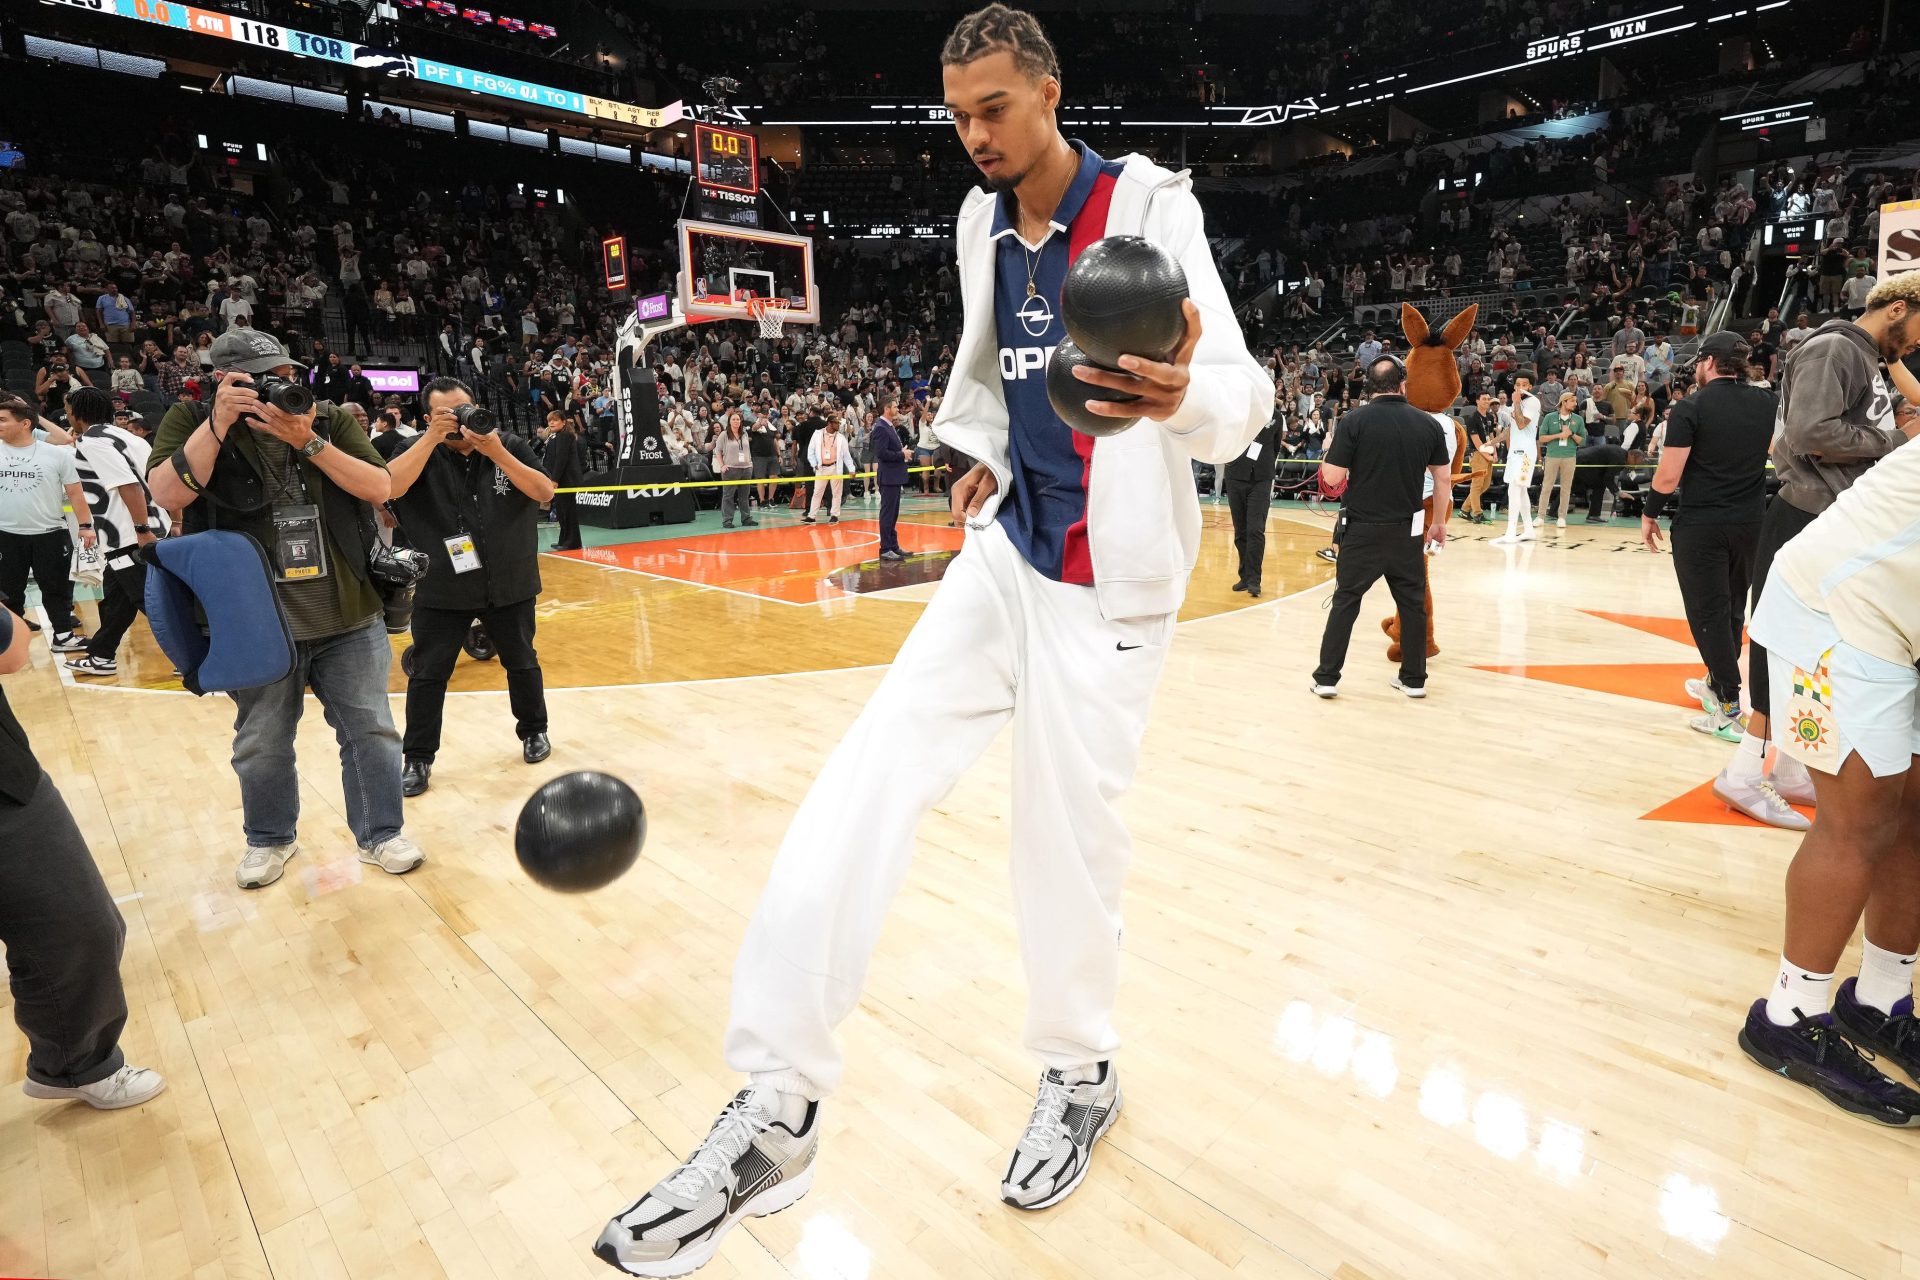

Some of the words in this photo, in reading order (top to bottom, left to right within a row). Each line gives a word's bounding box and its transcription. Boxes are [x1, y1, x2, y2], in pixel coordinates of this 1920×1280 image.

[196, 14, 224, 33] 4TH
[241, 21, 279, 47] 118
[295, 32, 344, 60] TOR
[1526, 36, 1581, 59] SPURS
[1609, 20, 1647, 40] WIN
[425, 64, 449, 80] PF
[472, 75, 516, 95] FG%
[544, 90, 567, 105] TO
[929, 109, 955, 120] SPU
[1741, 116, 1765, 125] SPURS
[1775, 111, 1791, 119] WIN
[712, 133, 738, 154] 0.0
[718, 190, 756, 204] TISSOT
[870, 227, 901, 235] SPURS
[914, 227, 934, 235] WIN
[388, 375, 413, 387] Go!
[621, 387, 634, 460] bet365
[640, 450, 664, 460] Frost
[0, 470, 36, 479] SPURS
[575, 491, 614, 507] ketmaster
